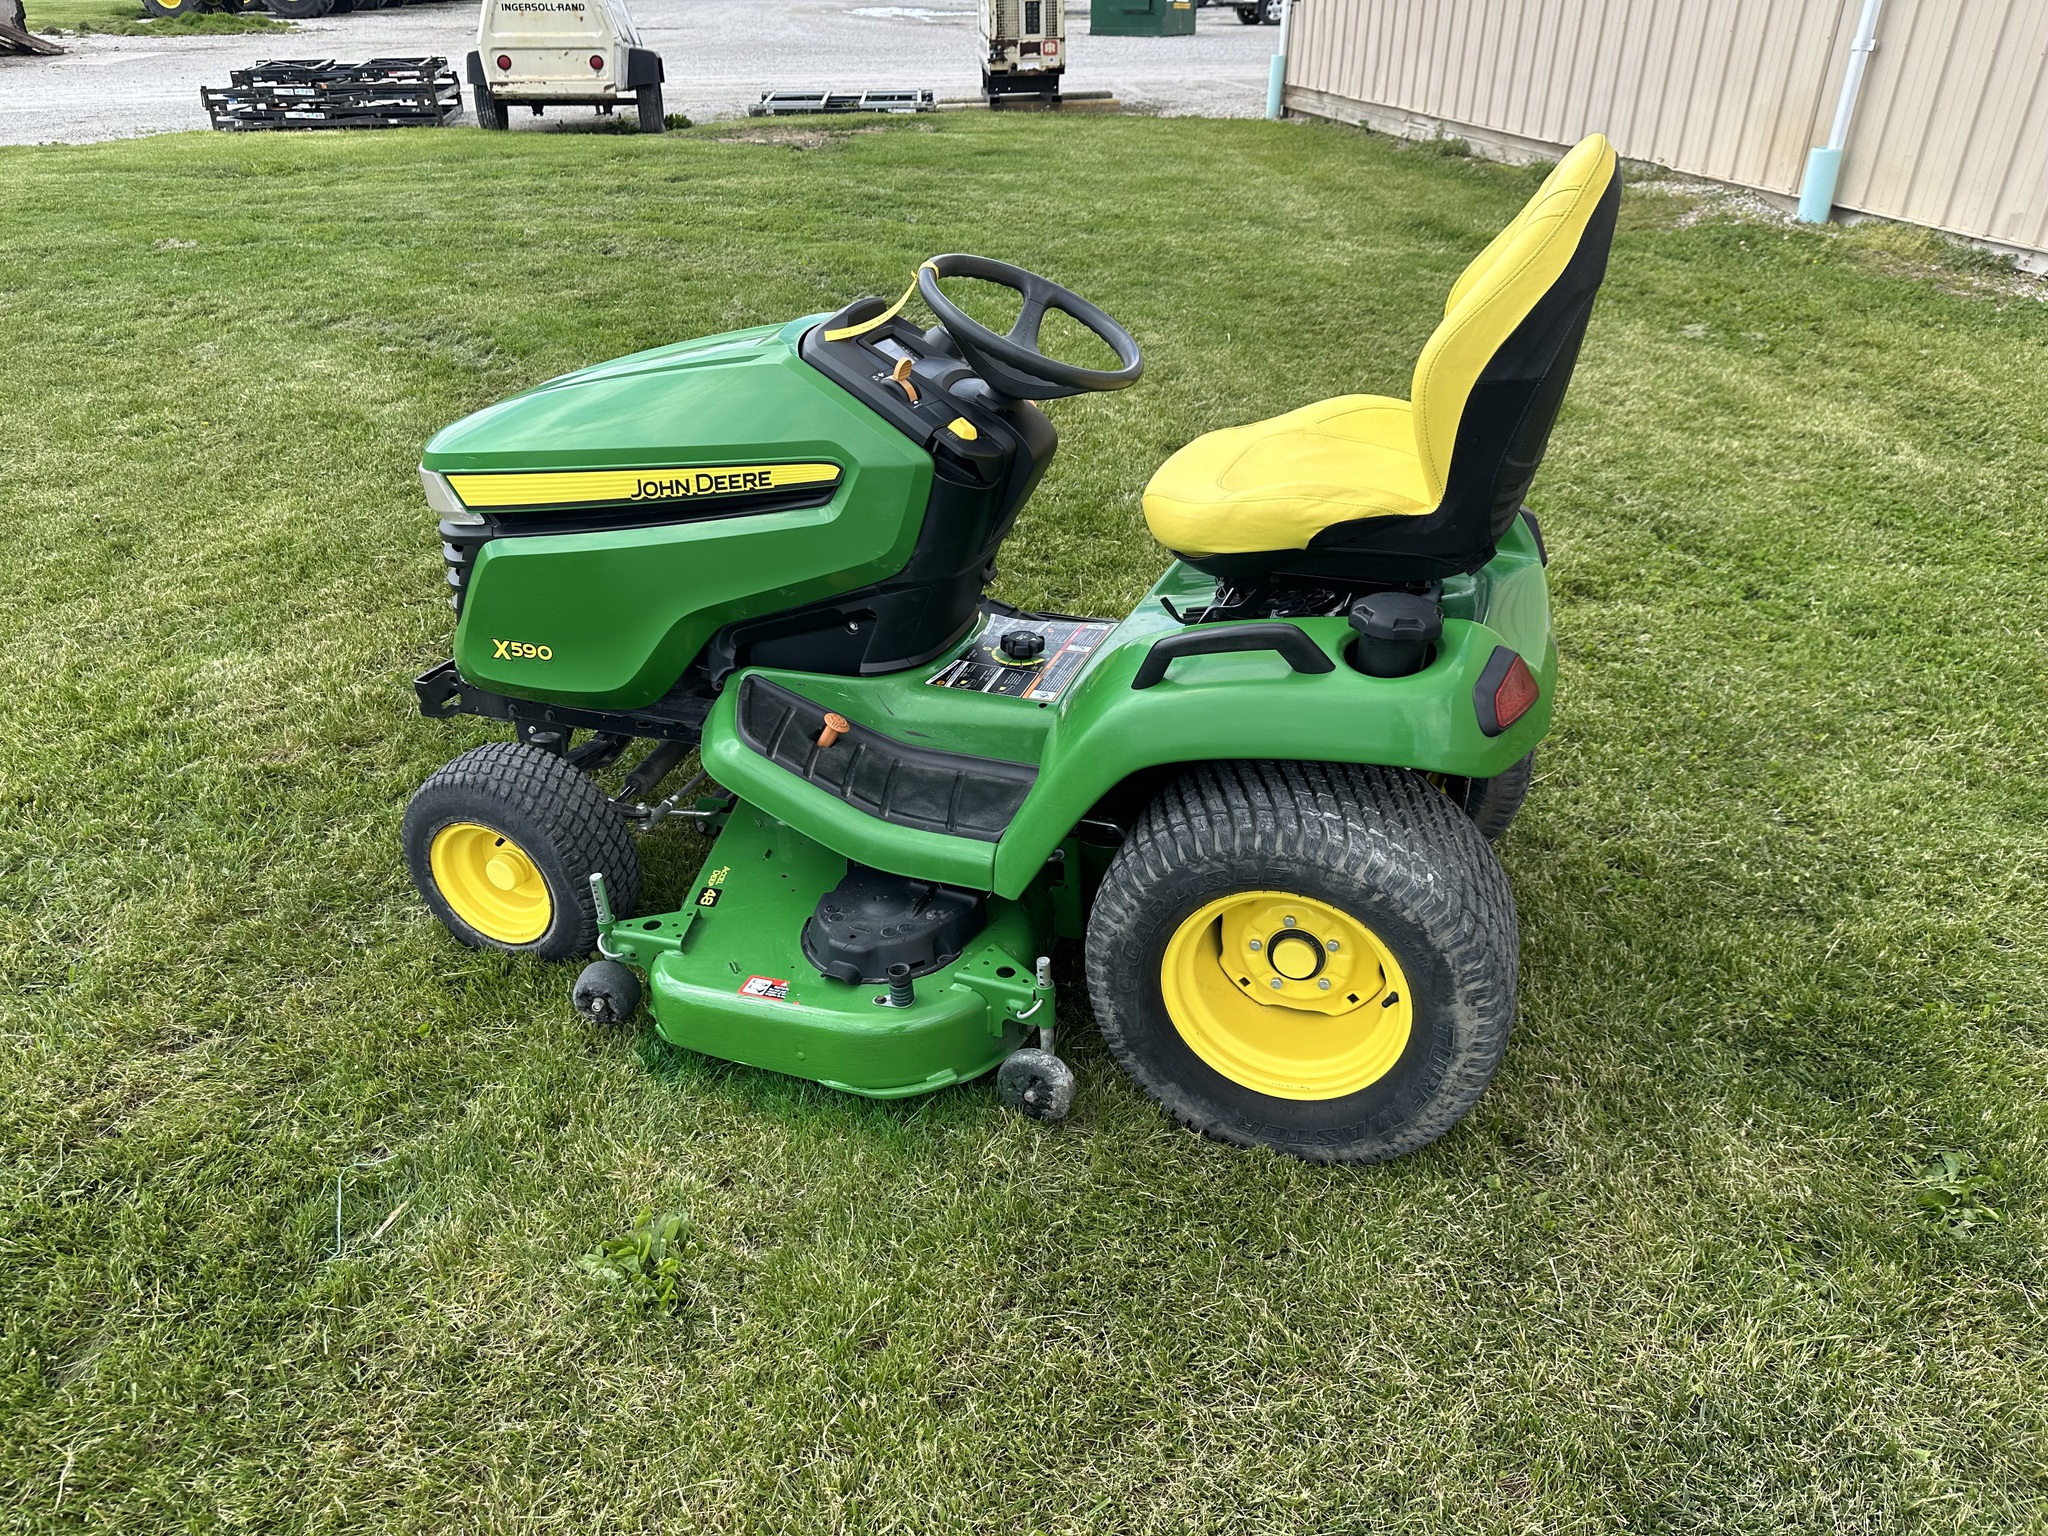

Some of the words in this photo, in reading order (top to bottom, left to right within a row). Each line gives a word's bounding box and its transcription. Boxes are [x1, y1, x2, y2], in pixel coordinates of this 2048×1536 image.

[501, 3, 586, 12] INGERSOLL-RAND
[631, 478, 690, 498] JOHN
[695, 471, 773, 492] DEERE
[492, 638, 553, 661] X590
[700, 889, 717, 905] 48
[1121, 863, 1292, 966] CARLISLE
[1411, 1023, 1457, 1114] TURF
[1234, 1104, 1407, 1148] MASTER
